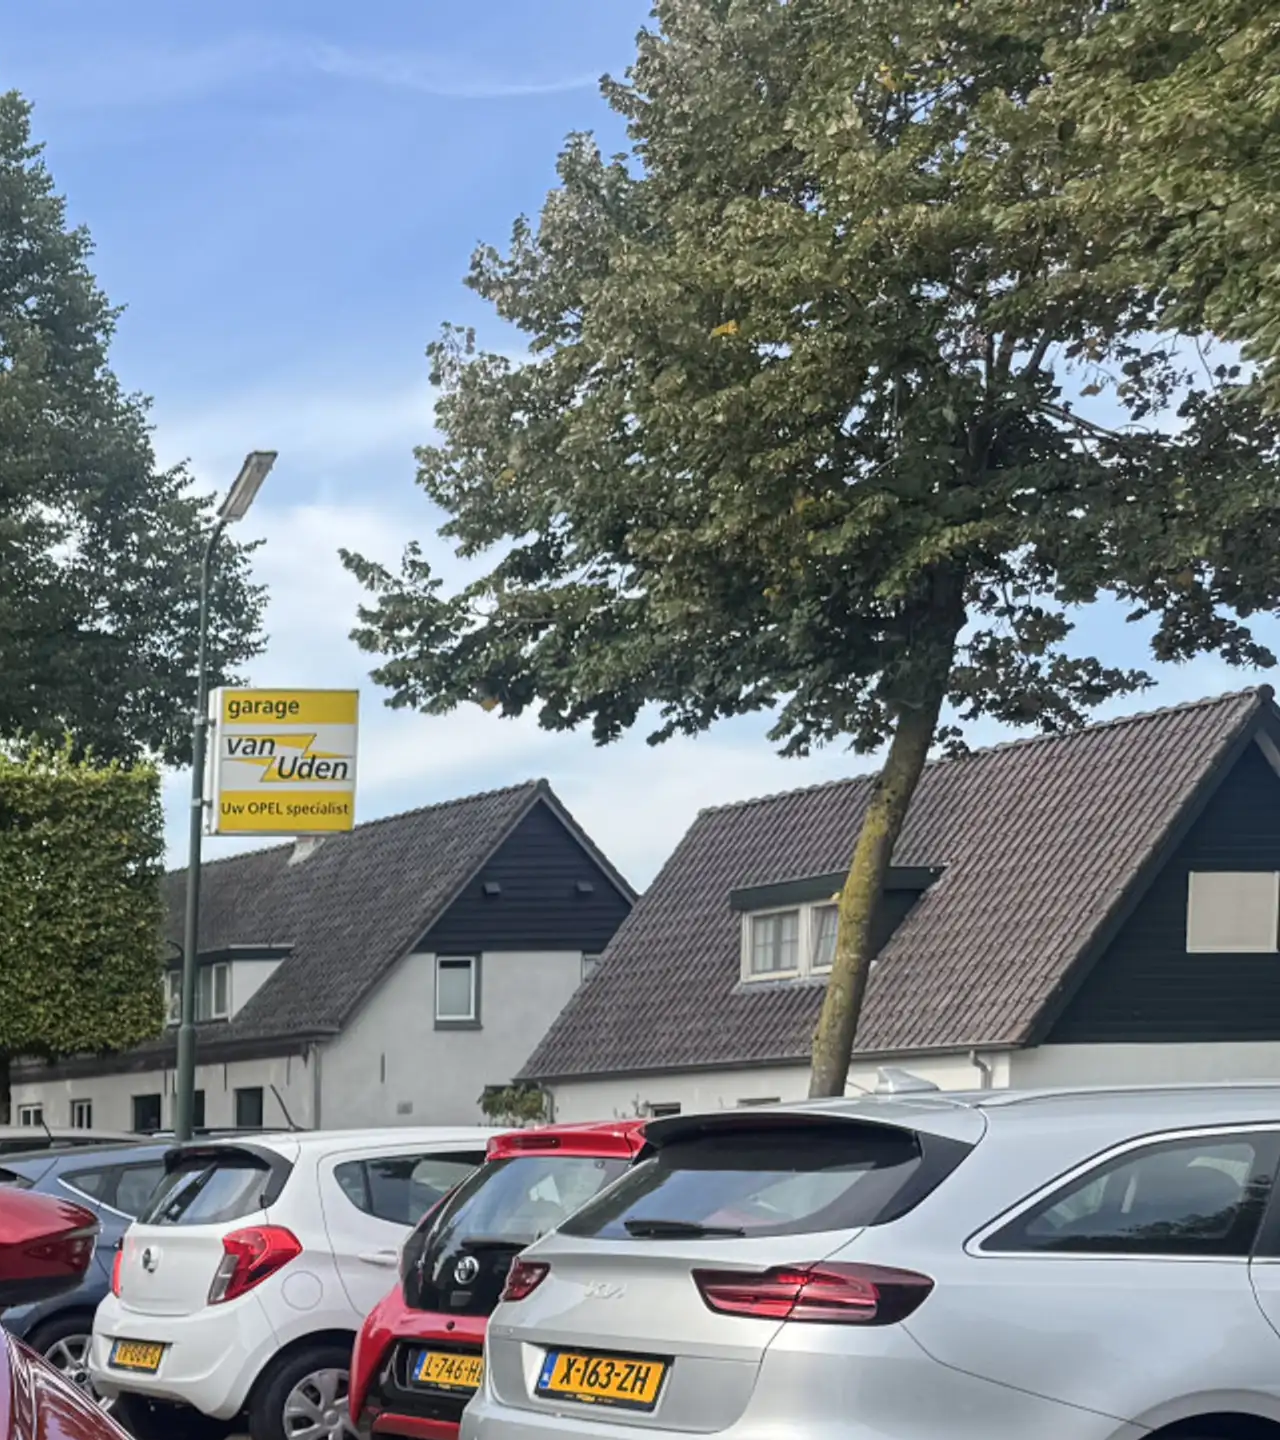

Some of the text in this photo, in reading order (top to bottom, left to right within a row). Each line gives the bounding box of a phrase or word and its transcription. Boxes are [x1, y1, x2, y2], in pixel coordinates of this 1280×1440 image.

[227, 698, 300, 719] garage
[227, 736, 276, 755] van
[277, 755, 348, 780] Uden
[221, 802, 349, 817] Uw OPEL specialist
[559, 1357, 652, 1395] X-163-ZH
